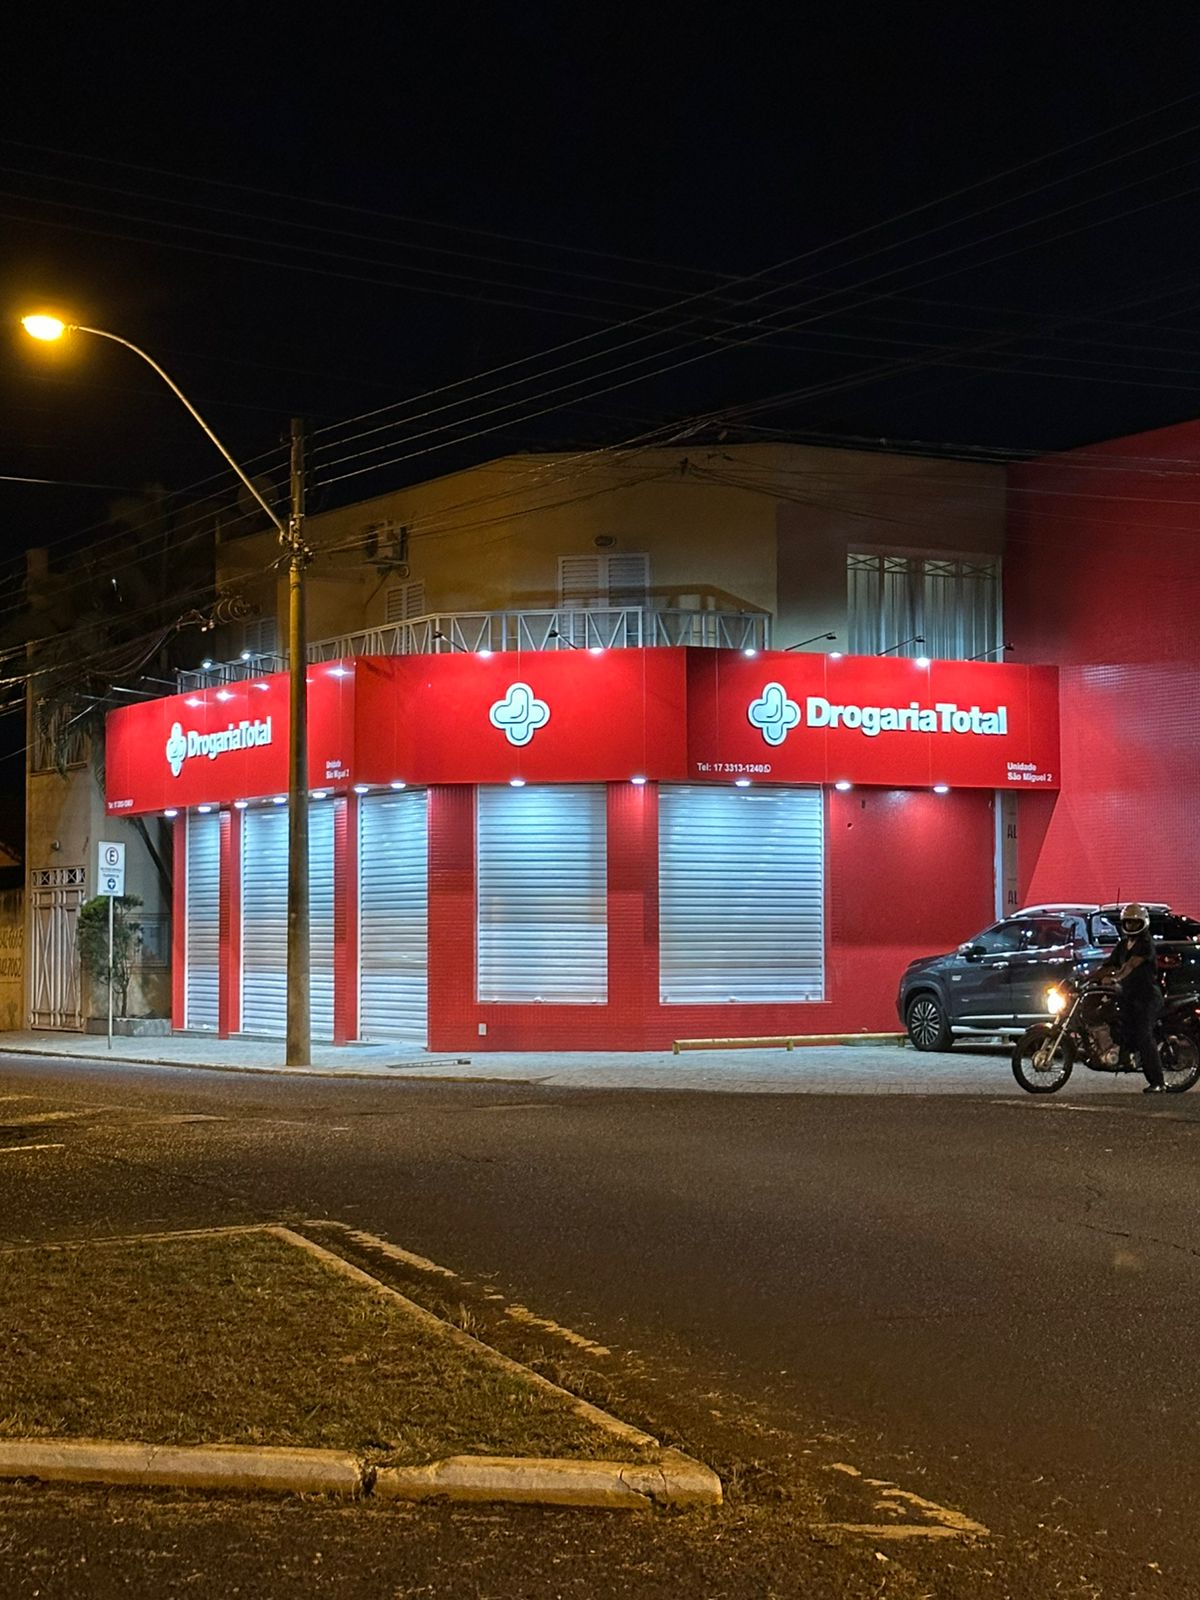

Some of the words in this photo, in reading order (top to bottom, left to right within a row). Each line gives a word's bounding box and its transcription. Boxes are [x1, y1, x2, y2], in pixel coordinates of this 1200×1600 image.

[806, 697, 1008, 736] DrogariaTotal
[697, 762, 711, 772] Tel:
[714, 763, 723, 772] 17
[1007, 762, 1037, 771] Unidade
[1047, 773, 1053, 782] 2
[109, 850, 115, 863] E
